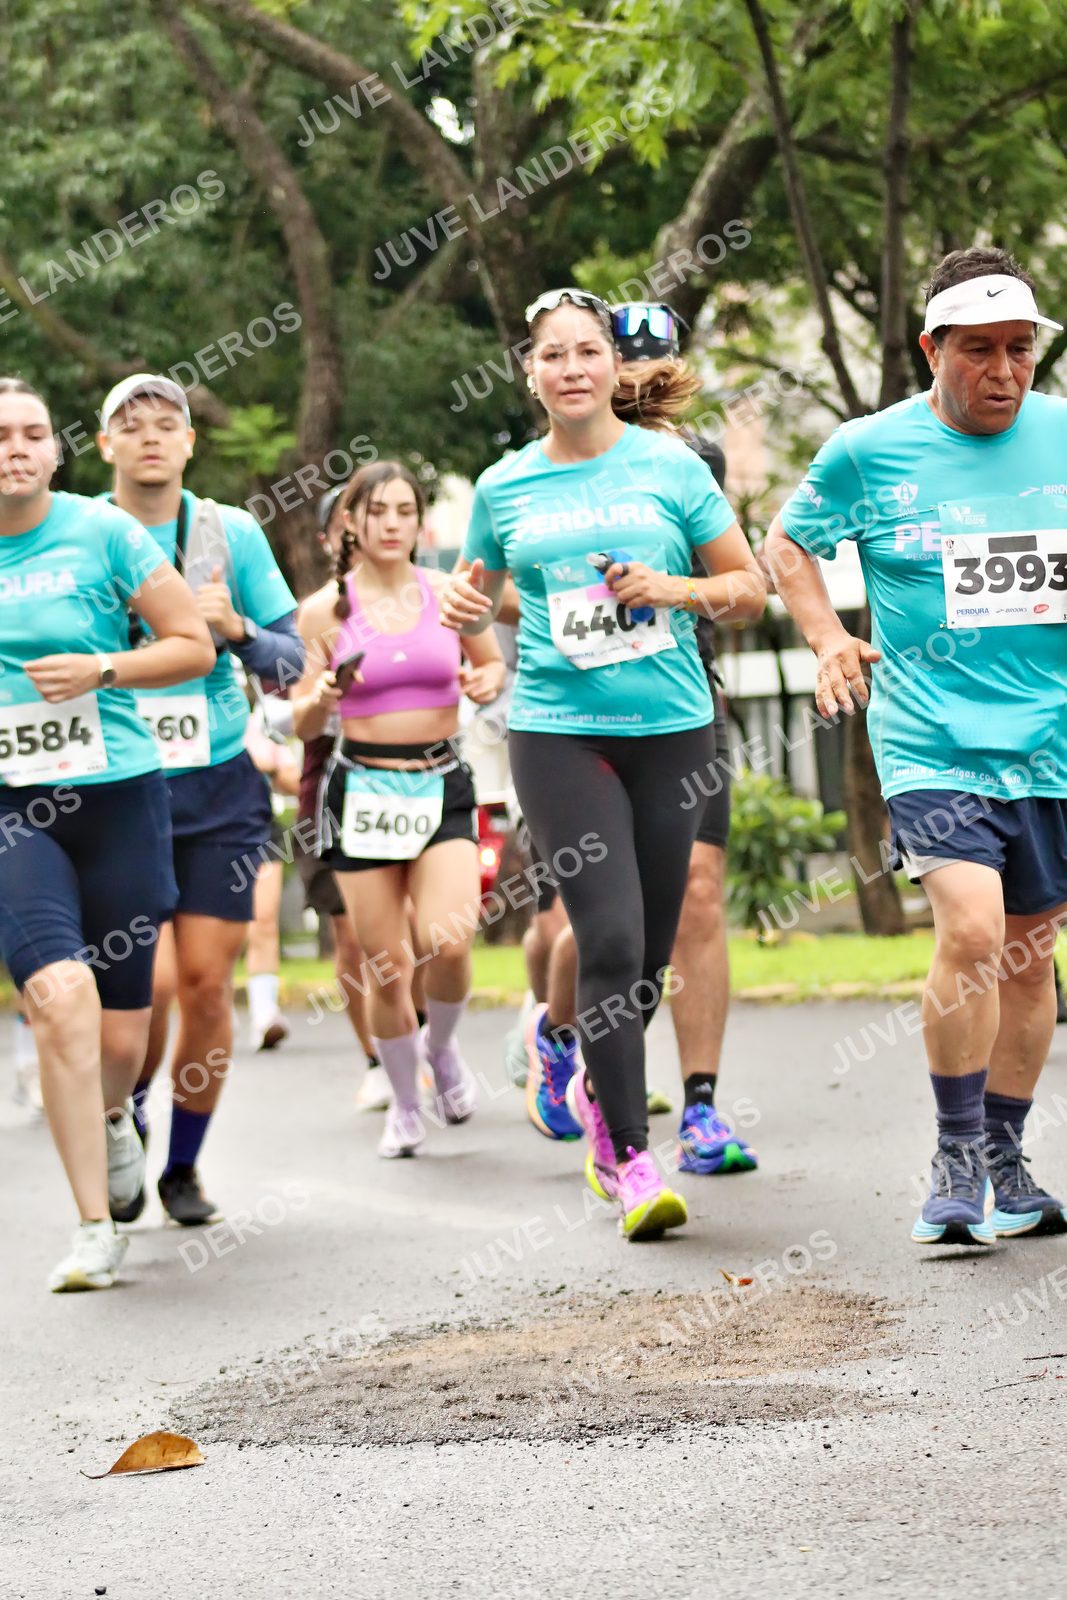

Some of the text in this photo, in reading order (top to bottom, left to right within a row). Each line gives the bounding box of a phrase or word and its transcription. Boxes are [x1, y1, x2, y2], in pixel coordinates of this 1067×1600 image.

[1042, 484, 1067, 496] BRO
[954, 554, 1067, 595] 3993
[562, 602, 657, 641] 440
[144, 714, 199, 742] 60
[354, 810, 431, 836] 5400
